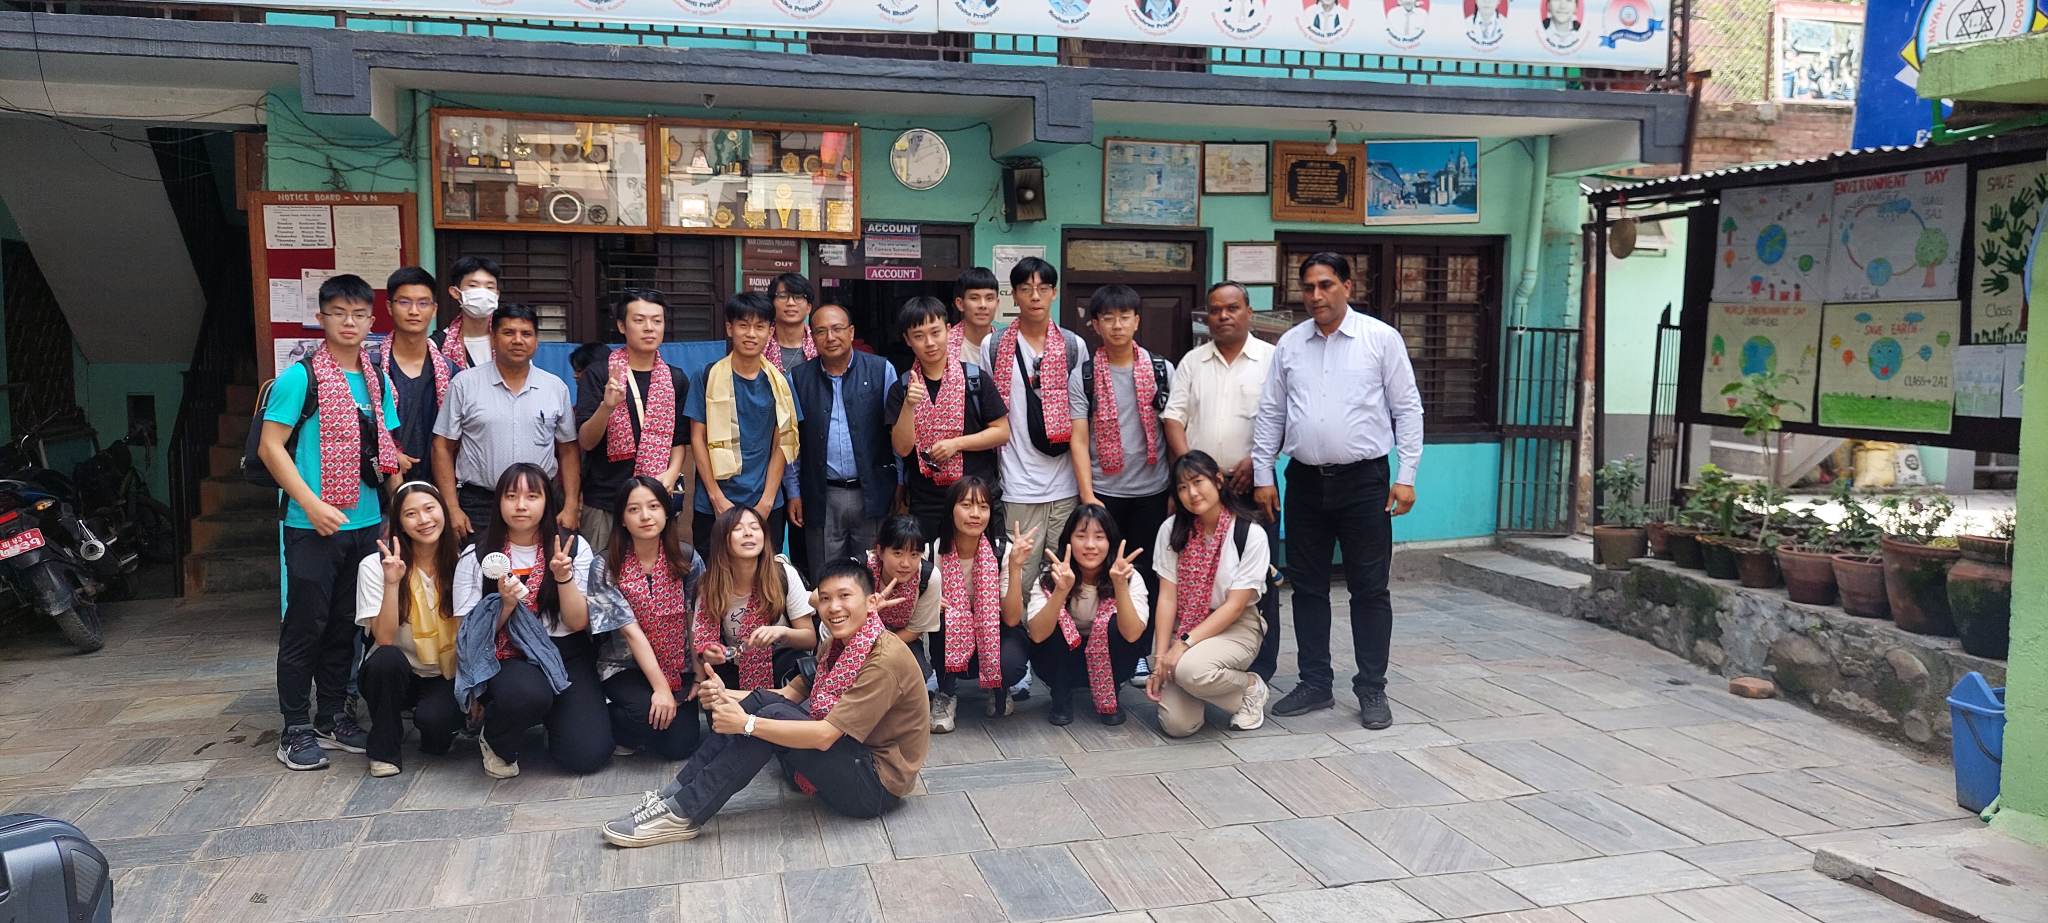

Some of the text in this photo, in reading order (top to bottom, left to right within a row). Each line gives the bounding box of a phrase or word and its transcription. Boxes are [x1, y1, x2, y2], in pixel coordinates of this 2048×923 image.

[1834, 168, 1950, 195] ENVIRONMENT DAY
[1987, 174, 2015, 192] SAVE
[277, 193, 309, 202] NOTICE
[314, 193, 342, 202] BOARD
[867, 223, 918, 233] ACCOUNT
[870, 268, 918, 279] ACCOUNT
[1985, 303, 2012, 319] Class
[1864, 324, 1882, 336] SAVE
